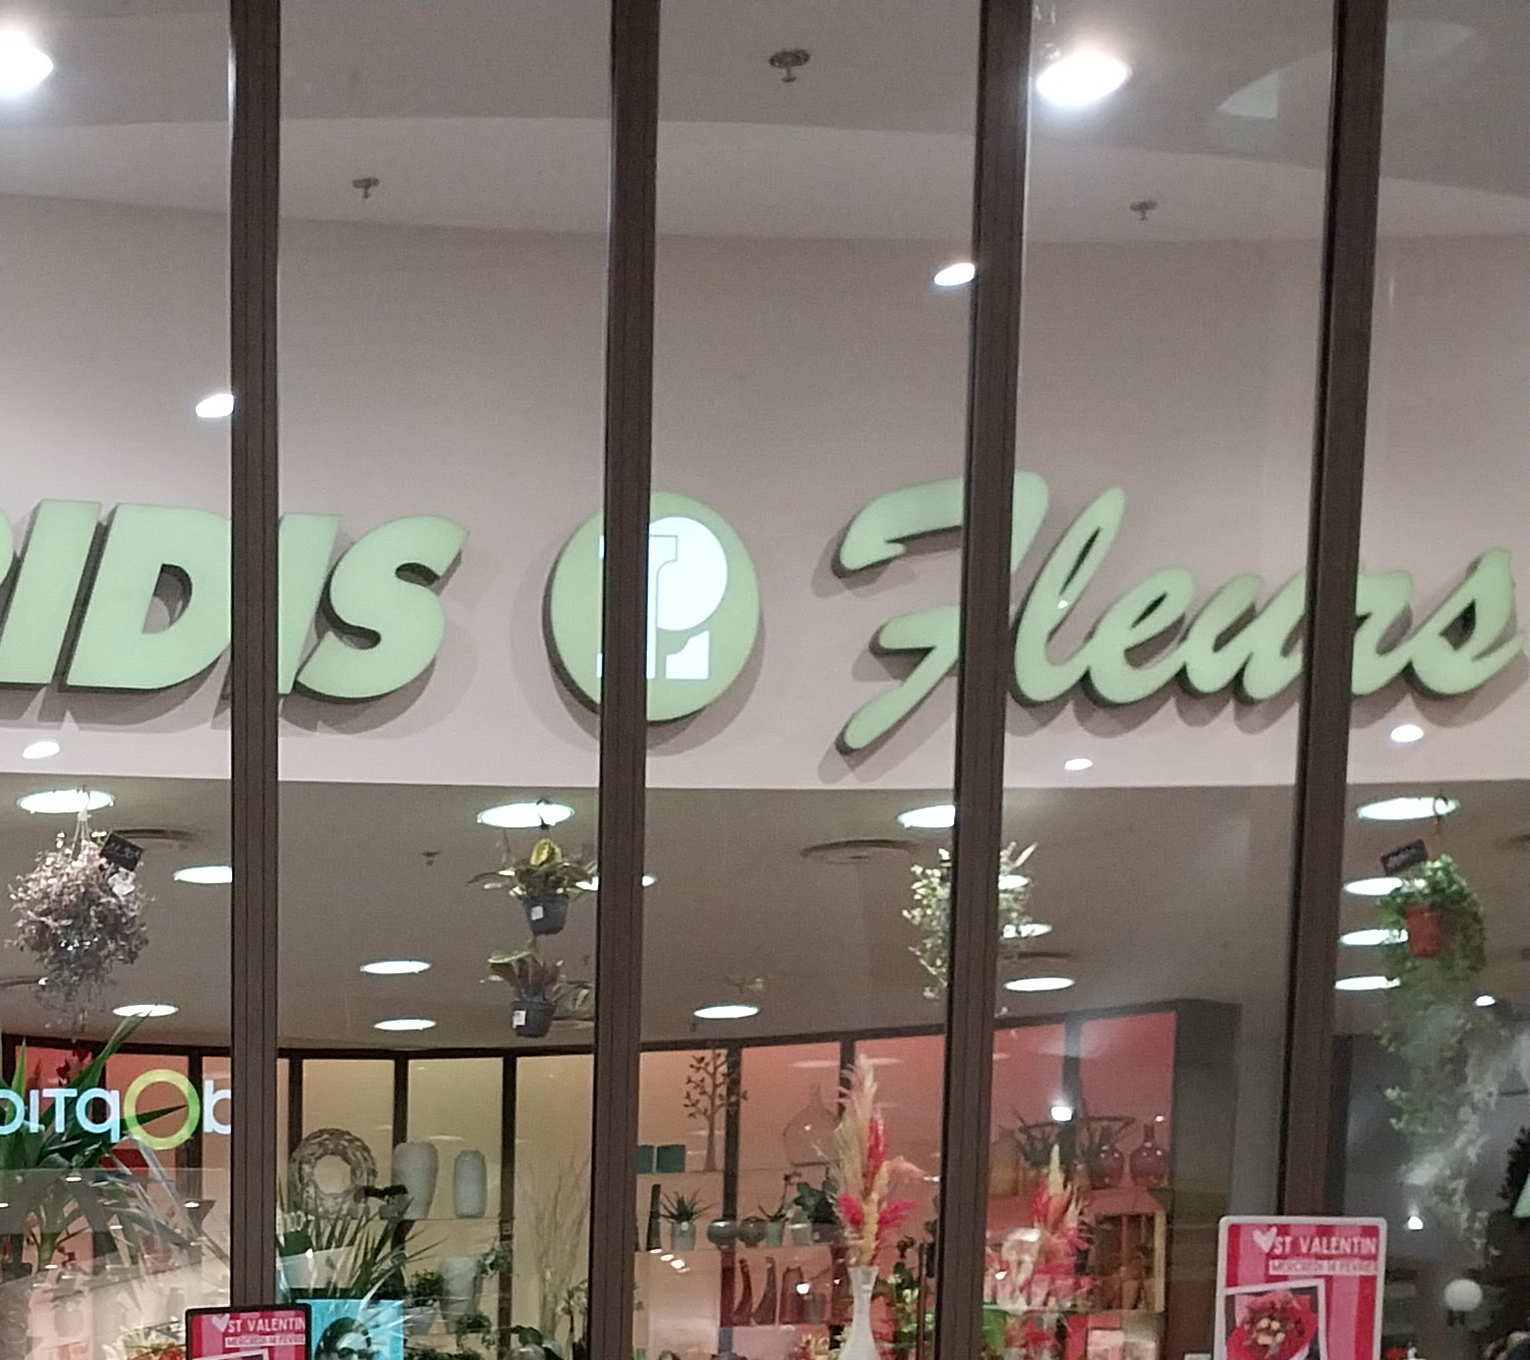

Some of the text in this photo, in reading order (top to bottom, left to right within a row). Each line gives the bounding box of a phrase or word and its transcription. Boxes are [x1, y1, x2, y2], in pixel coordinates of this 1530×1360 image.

[836, 470, 1529, 754] Fleurs
[1274, 1235, 1377, 1254] ST VALENTIN
[228, 1316, 306, 1332] ST VALENTIN
